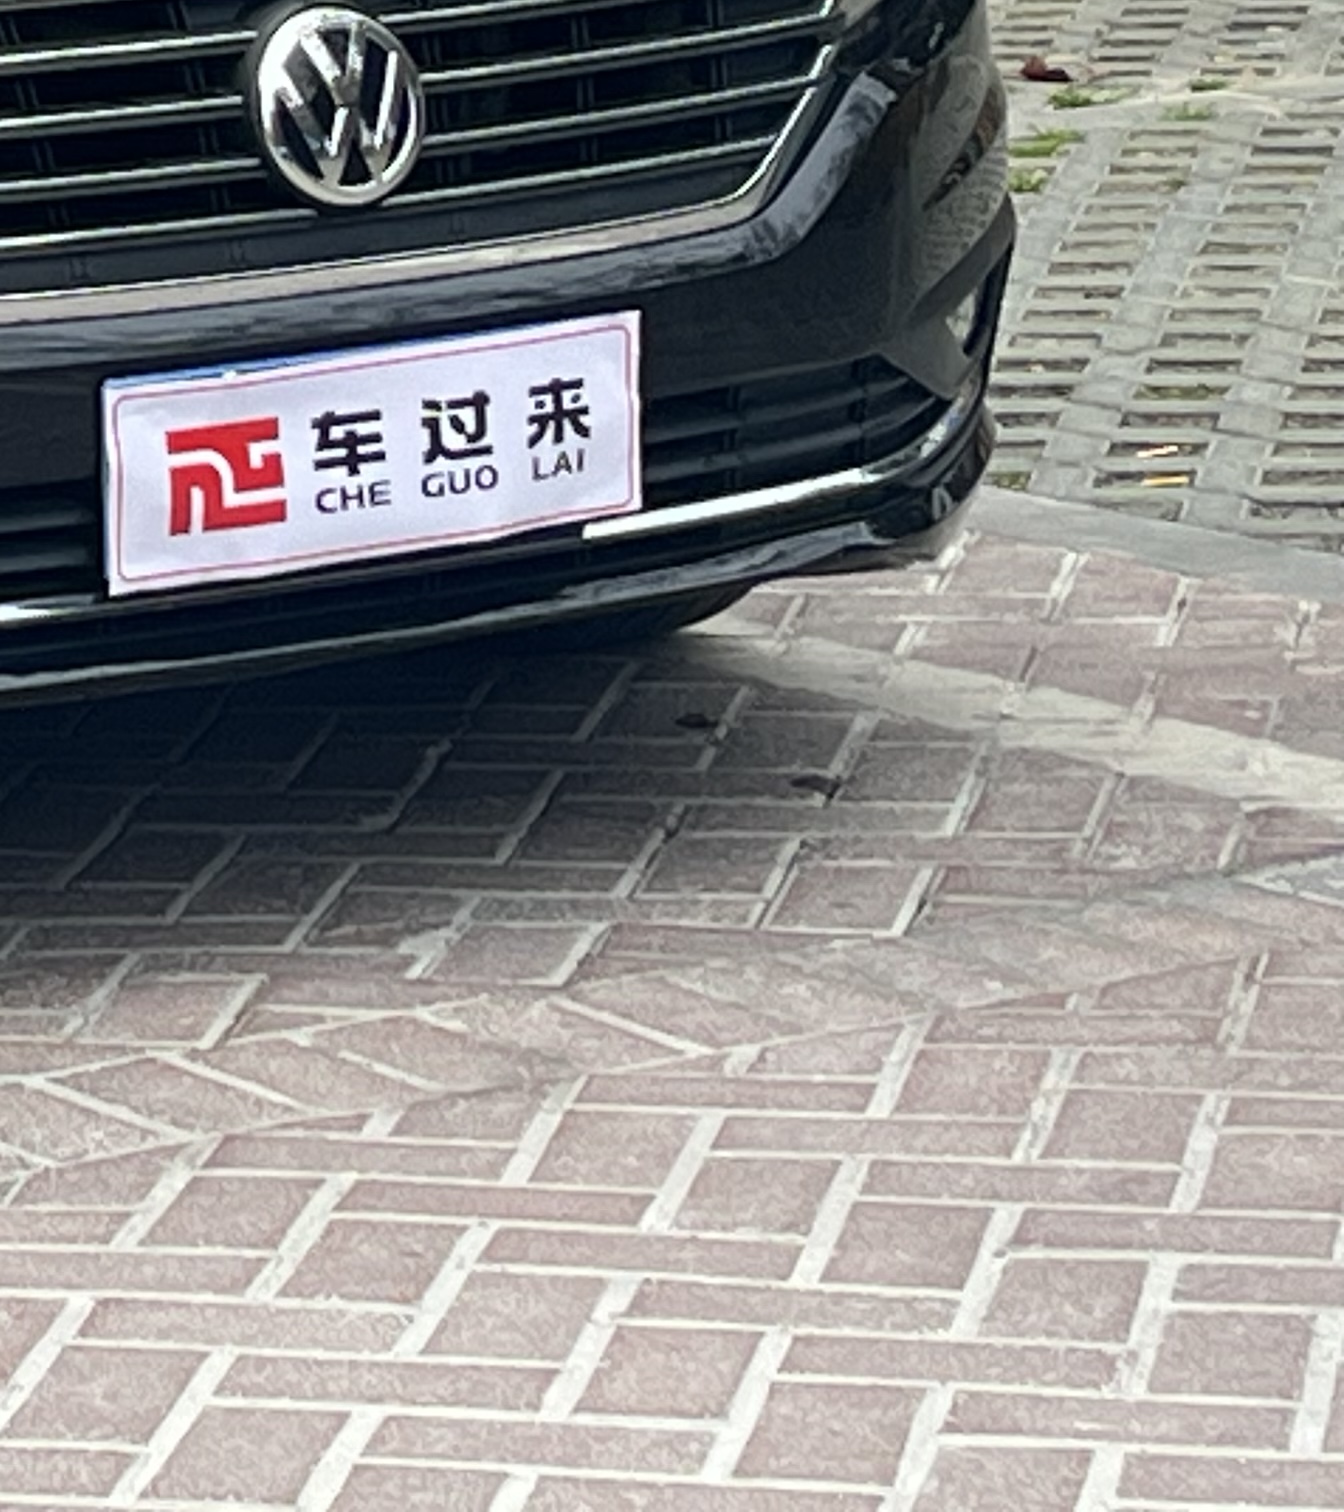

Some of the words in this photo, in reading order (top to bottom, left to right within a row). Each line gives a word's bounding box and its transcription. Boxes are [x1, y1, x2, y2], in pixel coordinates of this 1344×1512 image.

[311, 377, 592, 478] 车过来
[315, 480, 392, 514] CHE
[421, 465, 499, 498] GUO
[532, 449, 585, 481] LAI
